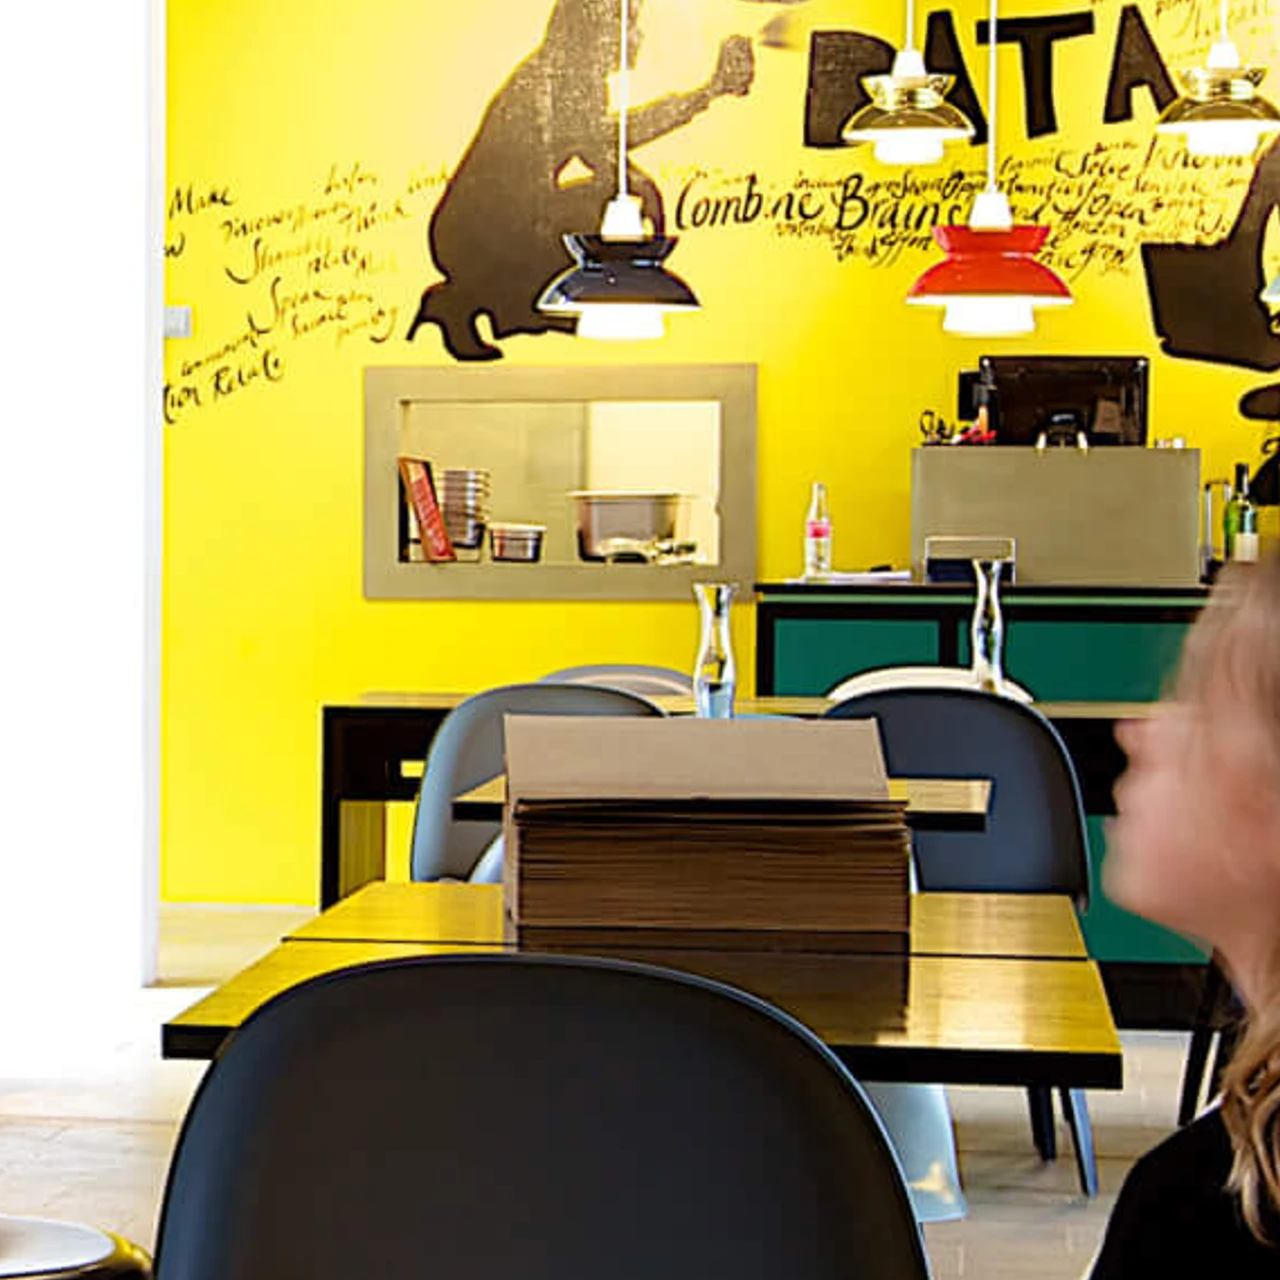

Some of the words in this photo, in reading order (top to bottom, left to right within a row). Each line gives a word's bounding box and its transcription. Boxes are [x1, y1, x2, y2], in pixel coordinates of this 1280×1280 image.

[803, 4, 1179, 150] DATA
[675, 171, 824, 231] Combine
[832, 173, 963, 232] Brains
